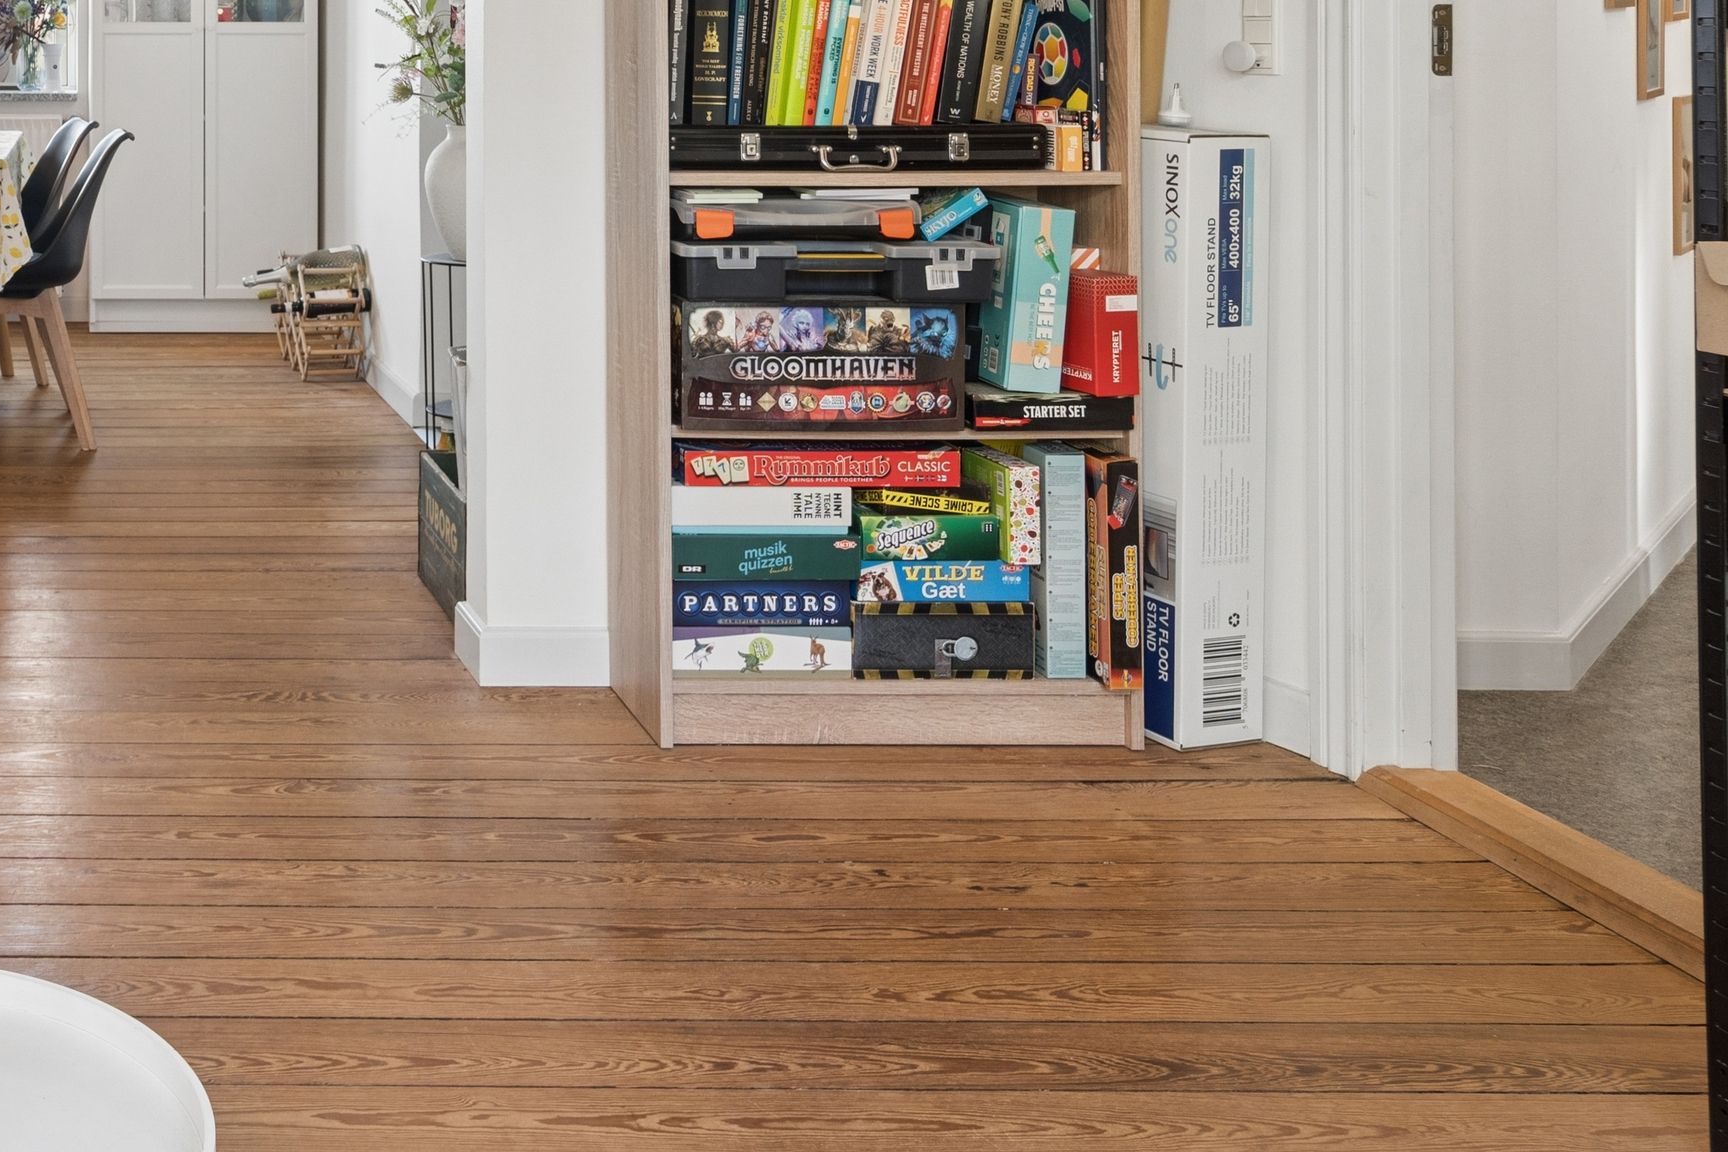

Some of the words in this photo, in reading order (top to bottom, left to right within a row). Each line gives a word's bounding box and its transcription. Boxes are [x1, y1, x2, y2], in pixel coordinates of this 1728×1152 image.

[752, 6, 760, 28] THROAT
[816, 0, 826, 30] MANSON
[873, 5, 887, 33] 4-HOUR
[922, 2, 930, 13] THE
[963, 0, 975, 32] WEALTH
[1024, 8, 1035, 26] THINK
[735, 14, 745, 52] FORRETNING
[916, 13, 928, 49] INTELLIGENT
[962, 33, 971, 45] OF
[993, 22, 1009, 62] ROBBINS
[735, 52, 743, 66] FOR
[773, 25, 785, 75] virksomhed
[831, 37, 842, 77] EVERYTHING
[869, 34, 883, 57] WORK
[1015, 49, 1024, 65] RICH
[865, 57, 877, 79] WEEK
[912, 49, 922, 77] INVESTOR
[956, 45, 969, 79] NATIONS
[1027, 57, 1036, 75] RICH
[732, 65, 742, 99] FREMTIDEN
[989, 64, 1004, 104] MONEY
[1026, 75, 1034, 92] DAD
[1046, 129, 1055, 168] QUICKIE
[1229, 165, 1243, 200] 32kg
[925, 210, 957, 237] SKYJO
[1207, 217, 1217, 261] STAND
[1229, 208, 1240, 269] 400x400
[1206, 264, 1216, 308] FLOOR
[1206, 312, 1215, 328] TV
[1228, 299, 1239, 323] 65"
[1033, 282, 1057, 370] CHEERS
[728, 356, 917, 382] GLOOMHAVEN
[1112, 330, 1120, 383] KRYPTERET
[1023, 405, 1068, 419] STARTER
[1068, 404, 1087, 418] SET
[753, 454, 890, 486] Rummikub
[897, 460, 951, 473] CLASSIC
[793, 492, 802, 519] MIME
[804, 492, 813, 519] TALE
[814, 492, 822, 519] NYNNE
[823, 492, 832, 519] TEGNE
[833, 492, 842, 519] HINT
[909, 495, 941, 509] SCENE
[943, 499, 974, 513] CRIME
[424, 488, 458, 555] TUBORG
[877, 520, 935, 551] Sequence
[744, 540, 788, 560] musik
[682, 565, 702, 573] DR
[738, 554, 793, 576] quizzen
[902, 565, 985, 581] VILDE
[683, 595, 837, 612] PARTNERS
[921, 582, 966, 599] Gæt
[1113, 574, 1124, 619] SUPER
[1126, 547, 1138, 646] CODEBREAKER
[1146, 600, 1157, 652] STAND
[1158, 606, 1169, 628] TV
[1158, 627, 1169, 683] FLOOR
